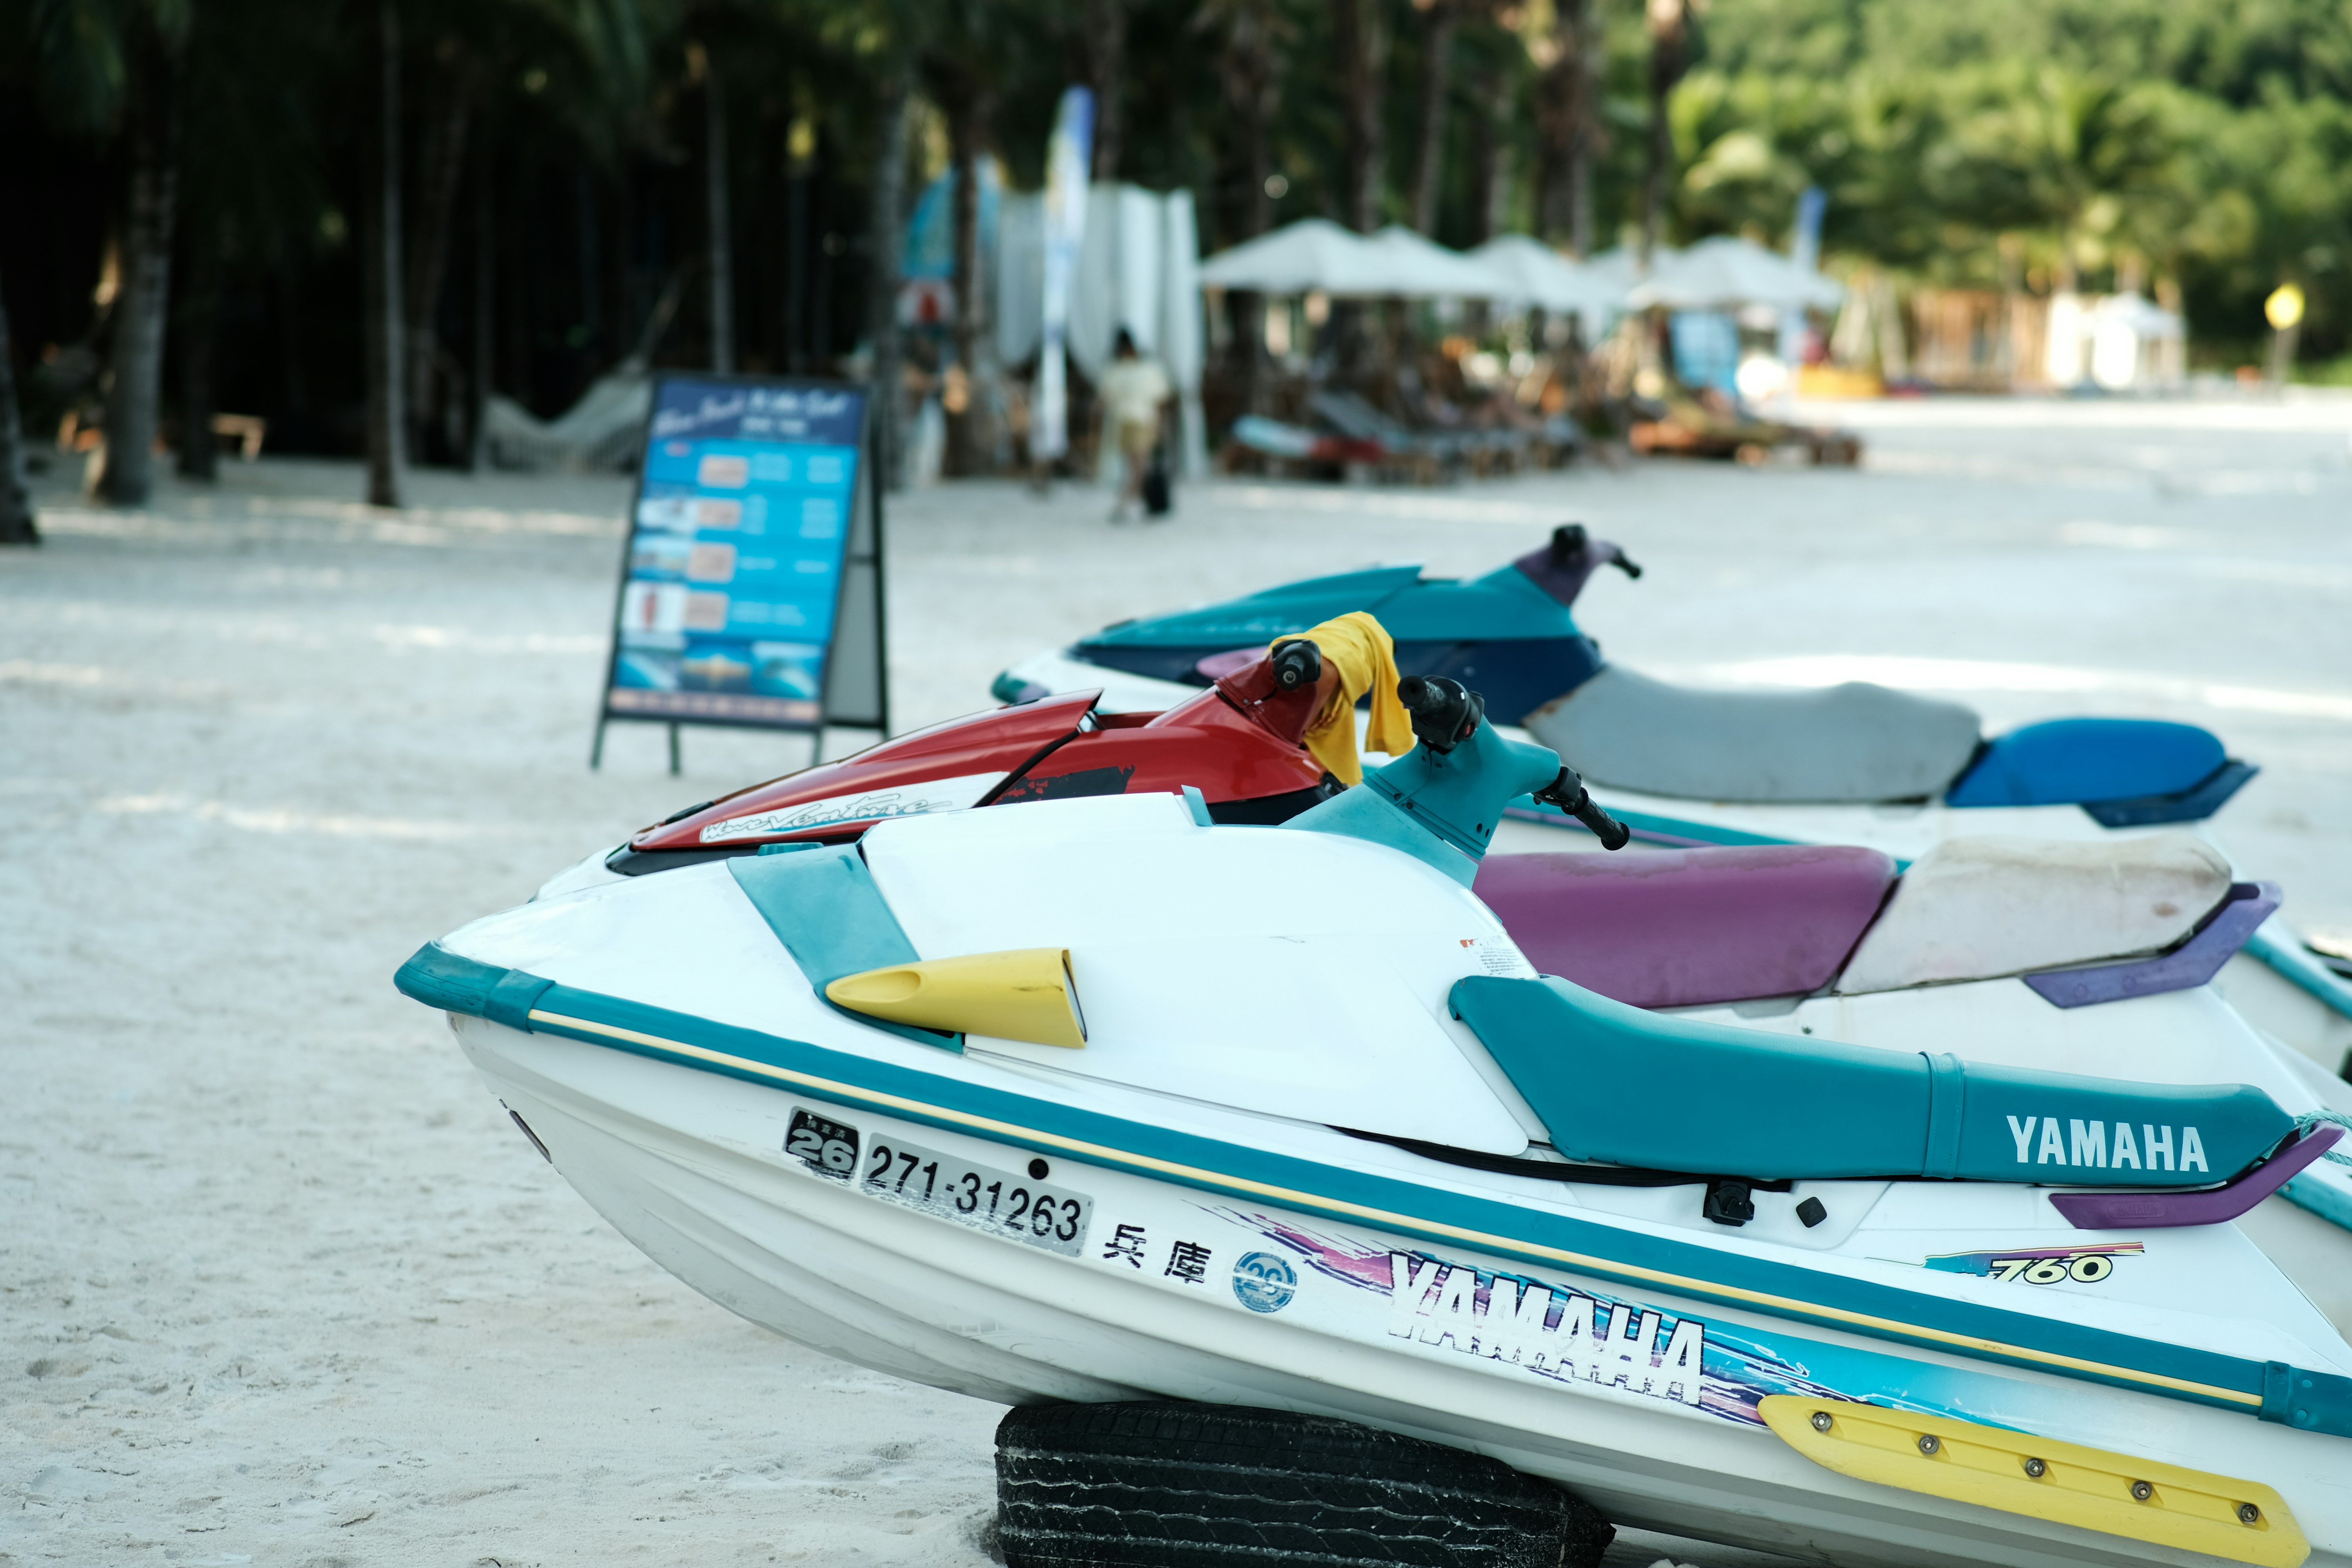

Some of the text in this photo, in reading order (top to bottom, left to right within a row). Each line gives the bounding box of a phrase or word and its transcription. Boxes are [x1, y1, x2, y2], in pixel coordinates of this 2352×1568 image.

[787, 1128, 855, 1171] 26
[2006, 1115, 2209, 1172] YAMAHA
[866, 1145, 1081, 1241] 271-31263
[1103, 1224, 1212, 1283] 兵庫
[1991, 1254, 2113, 1285] 760
[1389, 1251, 1705, 1405] YAMAHA
